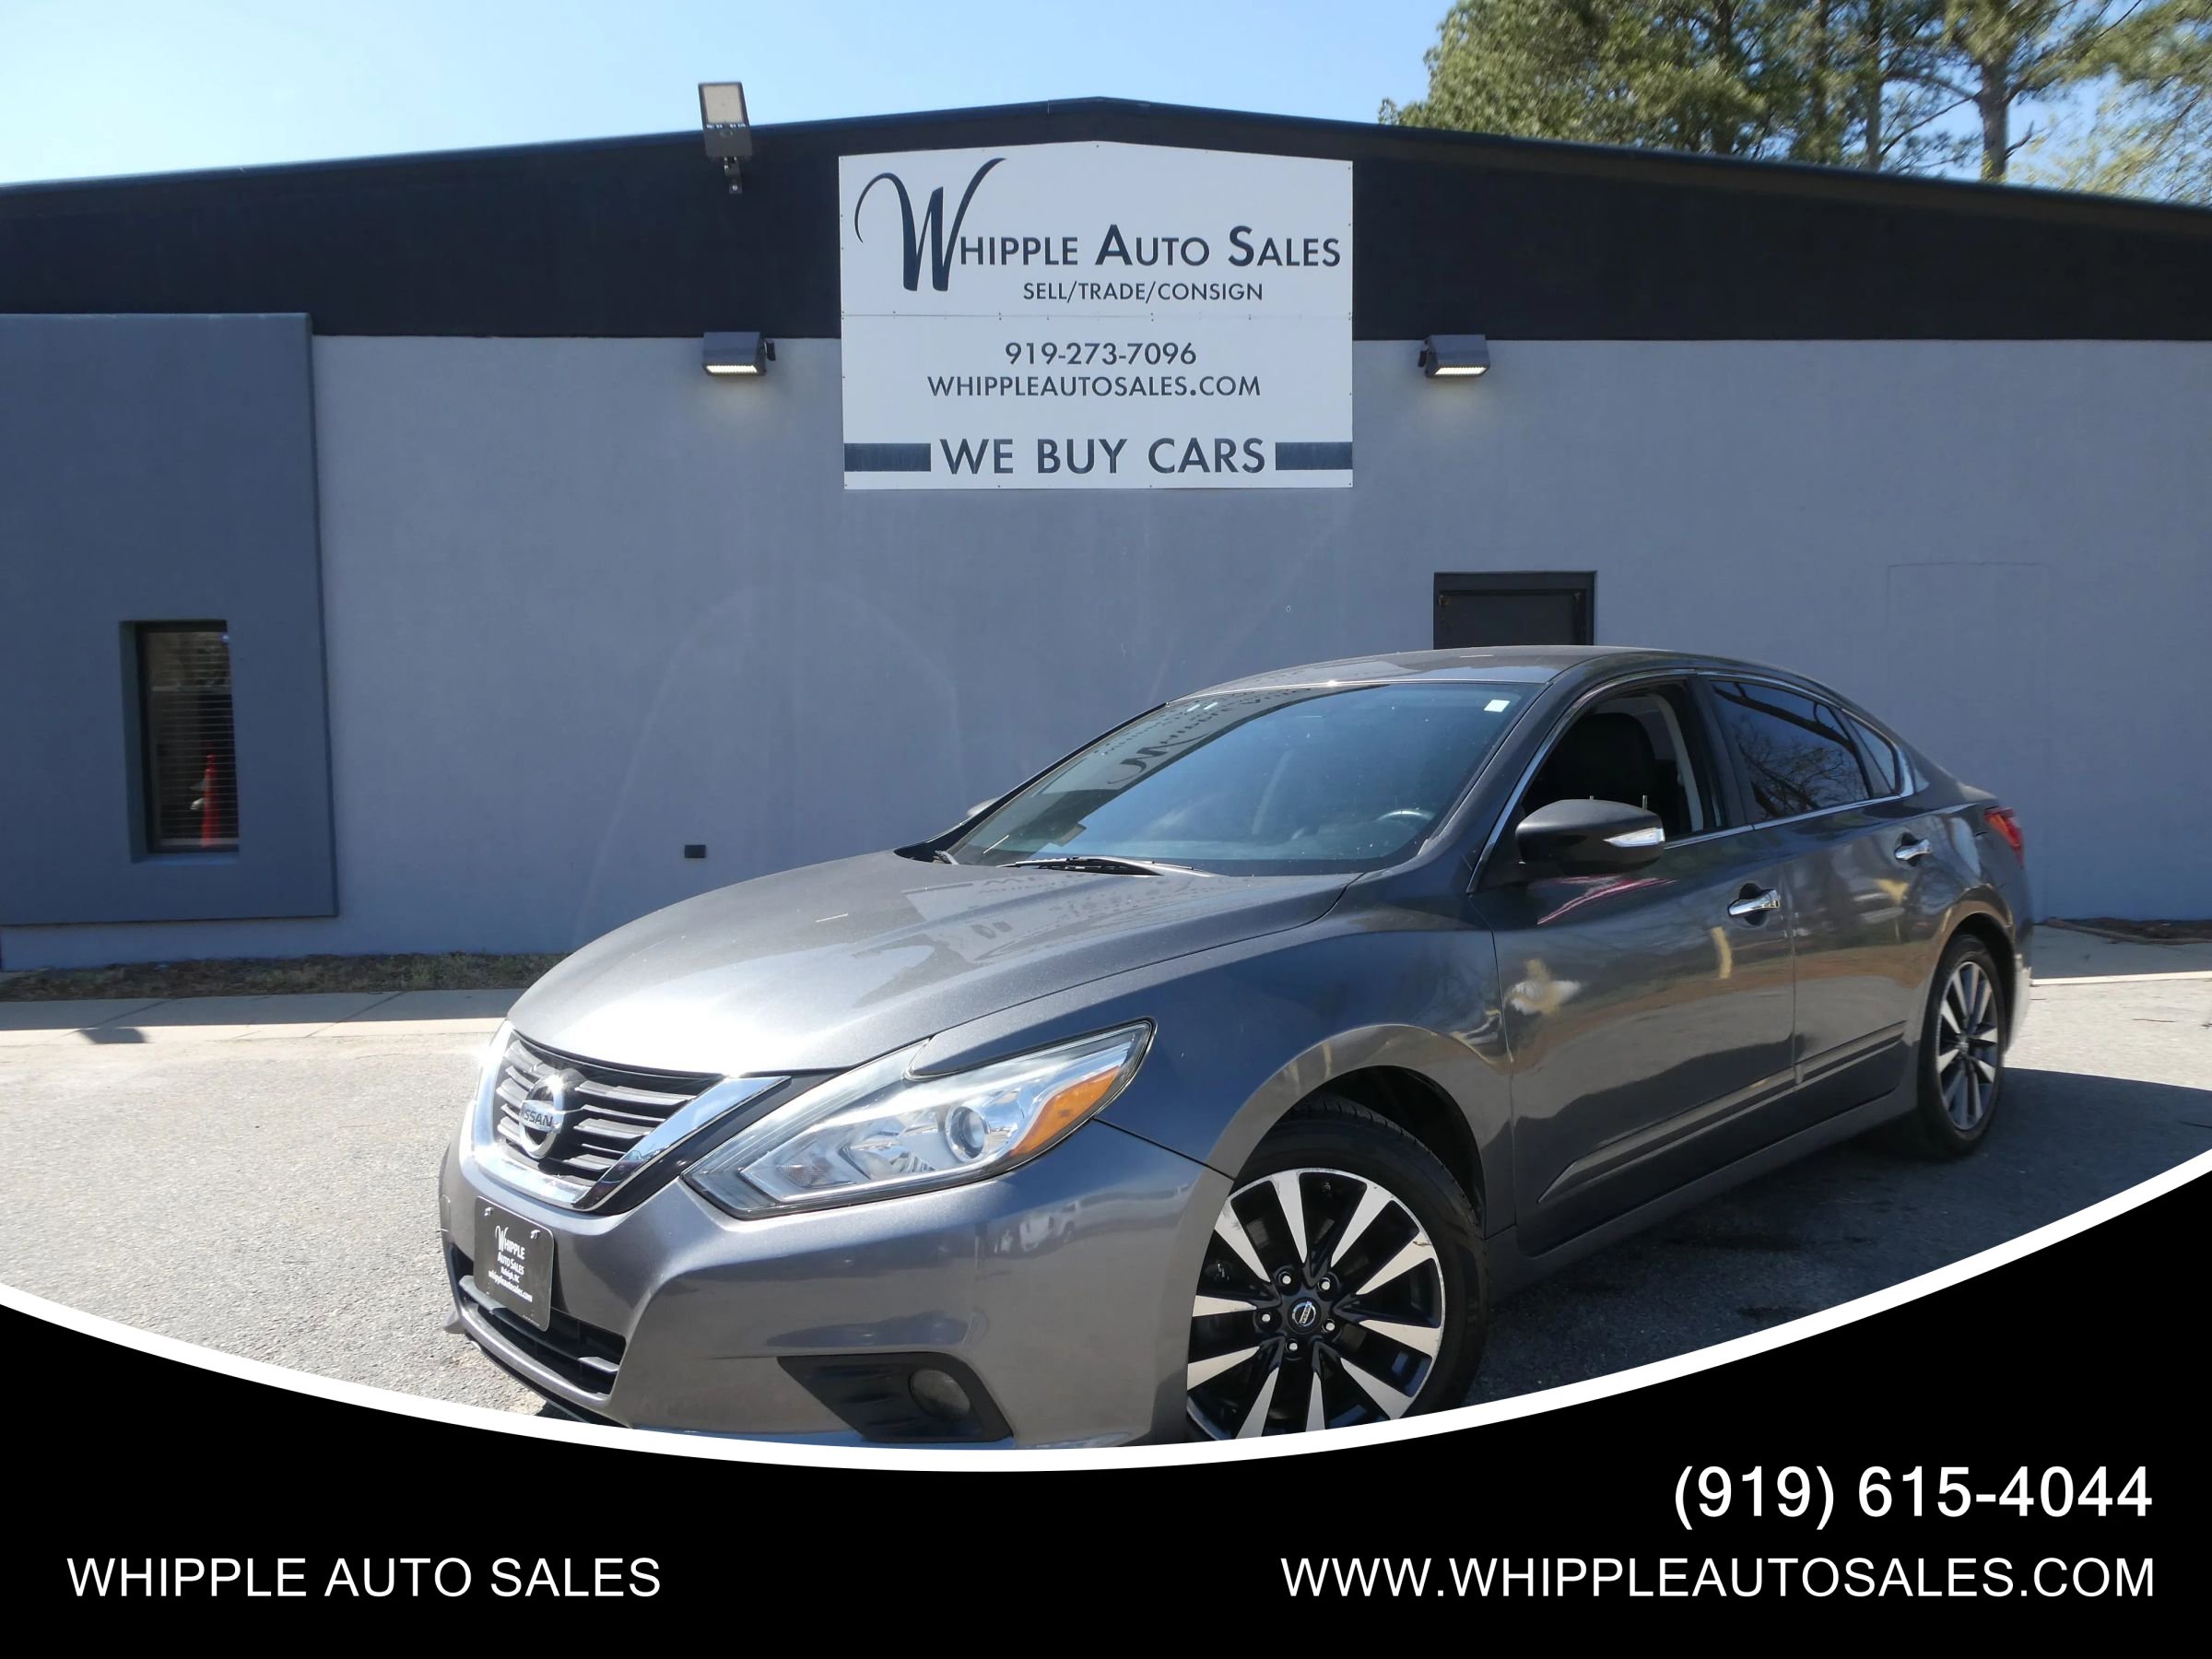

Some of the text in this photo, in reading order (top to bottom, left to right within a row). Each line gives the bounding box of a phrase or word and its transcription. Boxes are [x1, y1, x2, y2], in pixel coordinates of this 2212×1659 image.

[854, 158, 1341, 292] WHIPPLE AUTO SALES
[1023, 280, 1264, 304] SELL/TRADE/CONSIGN
[1005, 342, 1197, 366] 919-273-7096
[927, 375, 1261, 397] WHIPPLEAUTOSALES.COM
[939, 437, 1265, 475] WE BUY CARS
[495, 1226, 525, 1261] WHIPPLE
[511, 1258, 524, 1275] SALES
